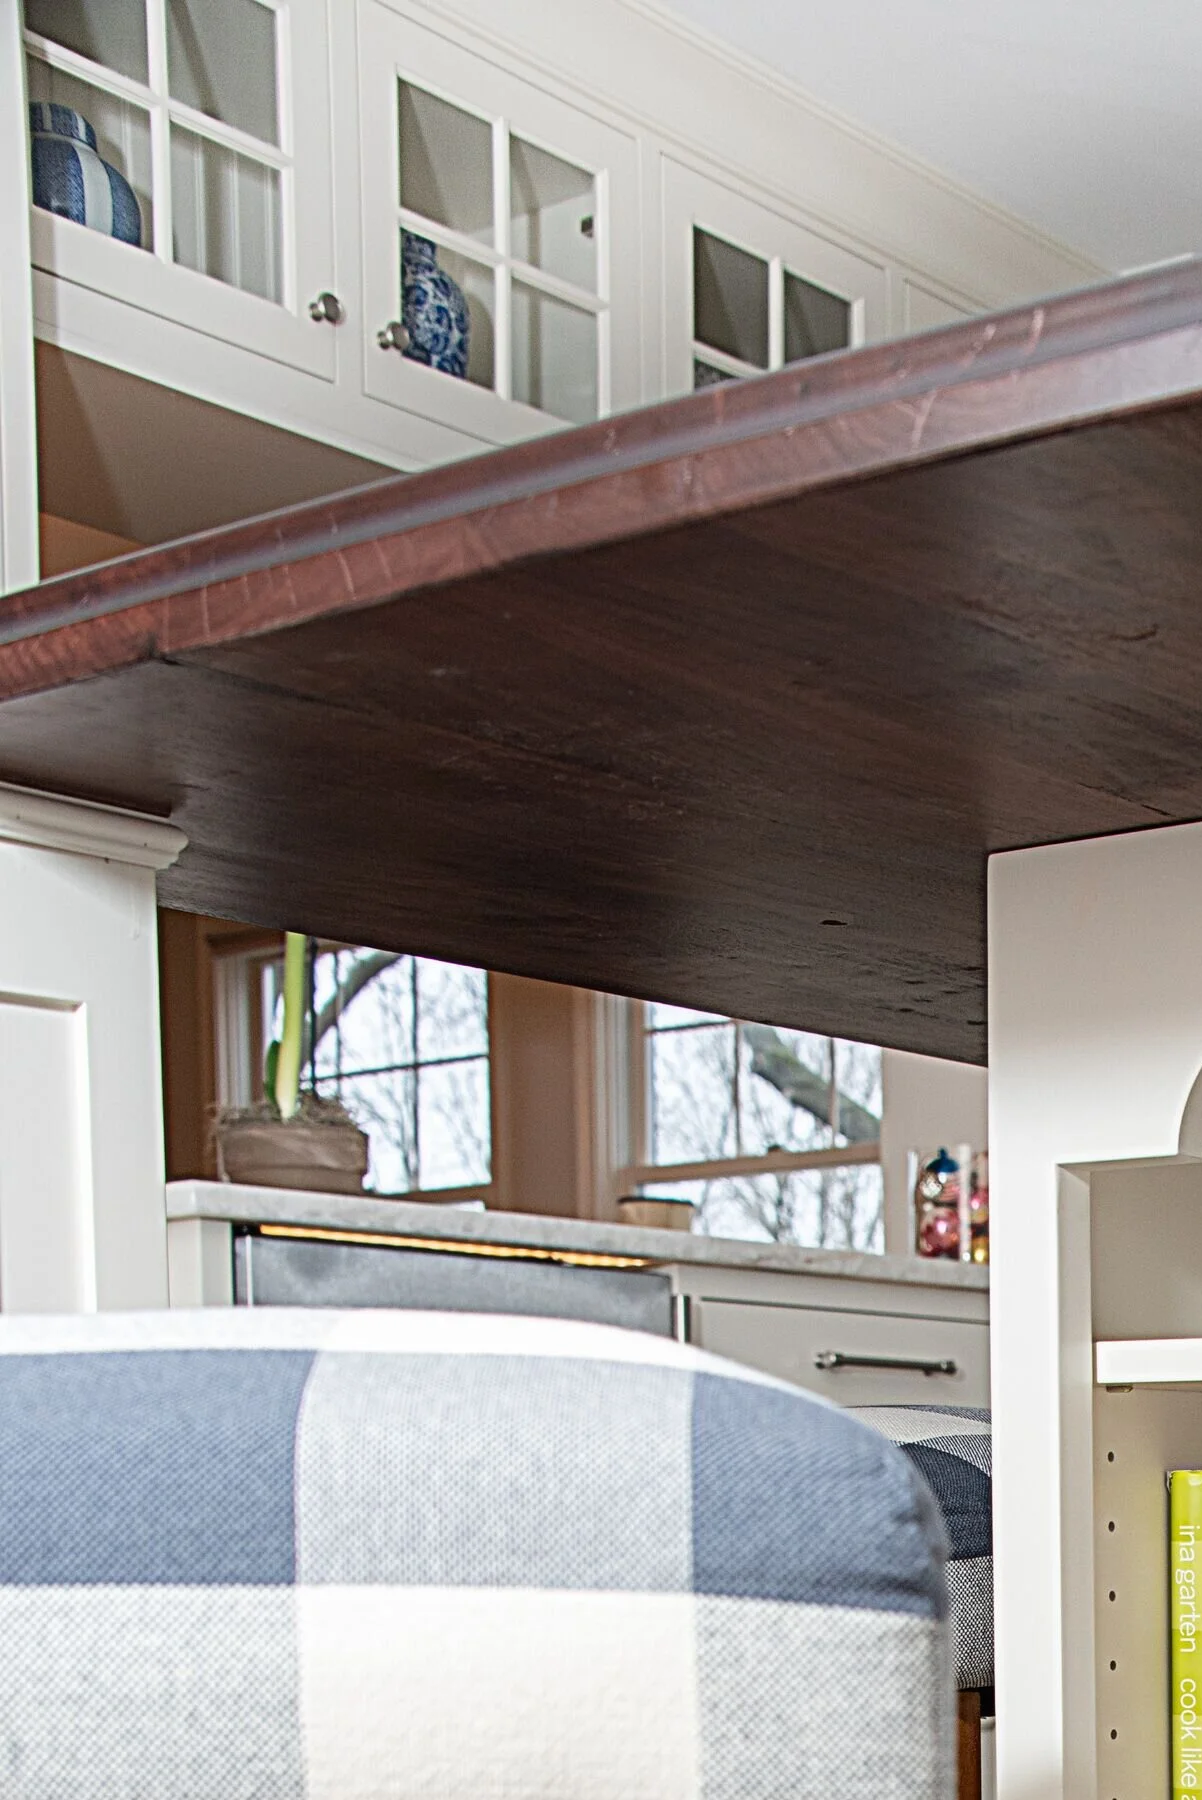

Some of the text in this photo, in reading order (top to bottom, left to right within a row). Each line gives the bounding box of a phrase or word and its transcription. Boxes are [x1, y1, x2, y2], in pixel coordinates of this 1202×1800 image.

[1176, 1525, 1200, 1653] ina garten
[1180, 1678, 1202, 1740] cook
[1180, 1748, 1202, 1788] like
